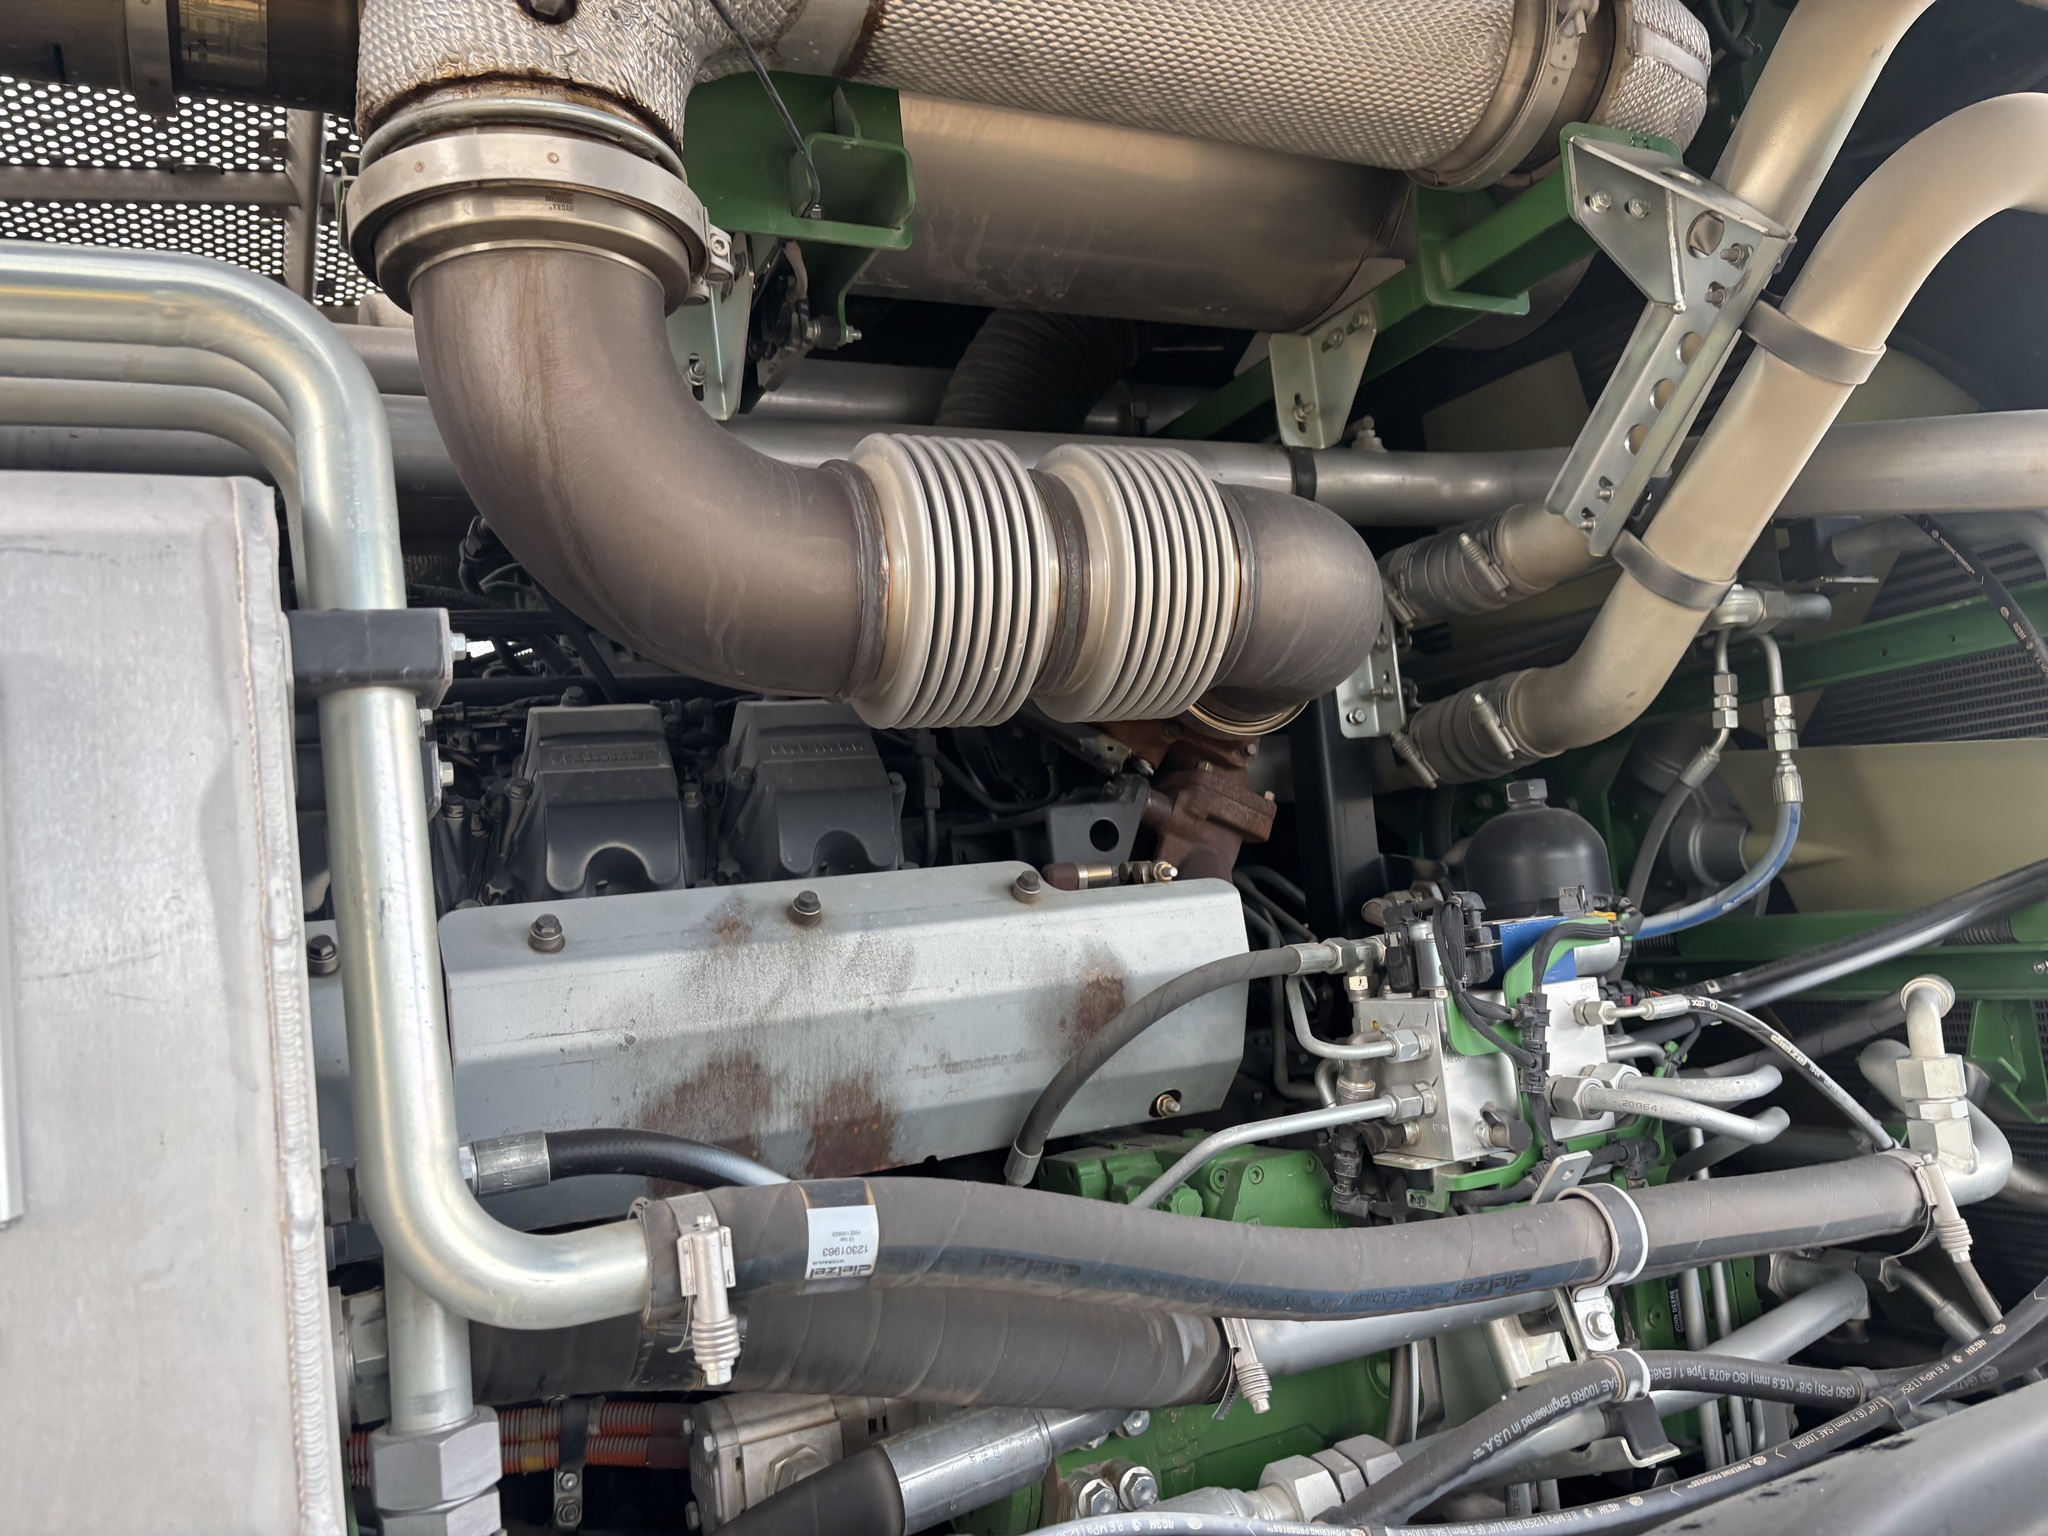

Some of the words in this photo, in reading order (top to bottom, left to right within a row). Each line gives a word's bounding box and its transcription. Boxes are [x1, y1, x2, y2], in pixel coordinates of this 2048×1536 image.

[822, 1244, 868, 1257] 12301963
[1686, 1365, 1709, 1381] Type
[1709, 1368, 1732, 1382] 4079
[1571, 1382, 1600, 1403] 100R6
[1520, 1393, 1572, 1427] Engineered
[1817, 1422, 1835, 1438] SAE
[1482, 1427, 1513, 1452] U.S.A.
